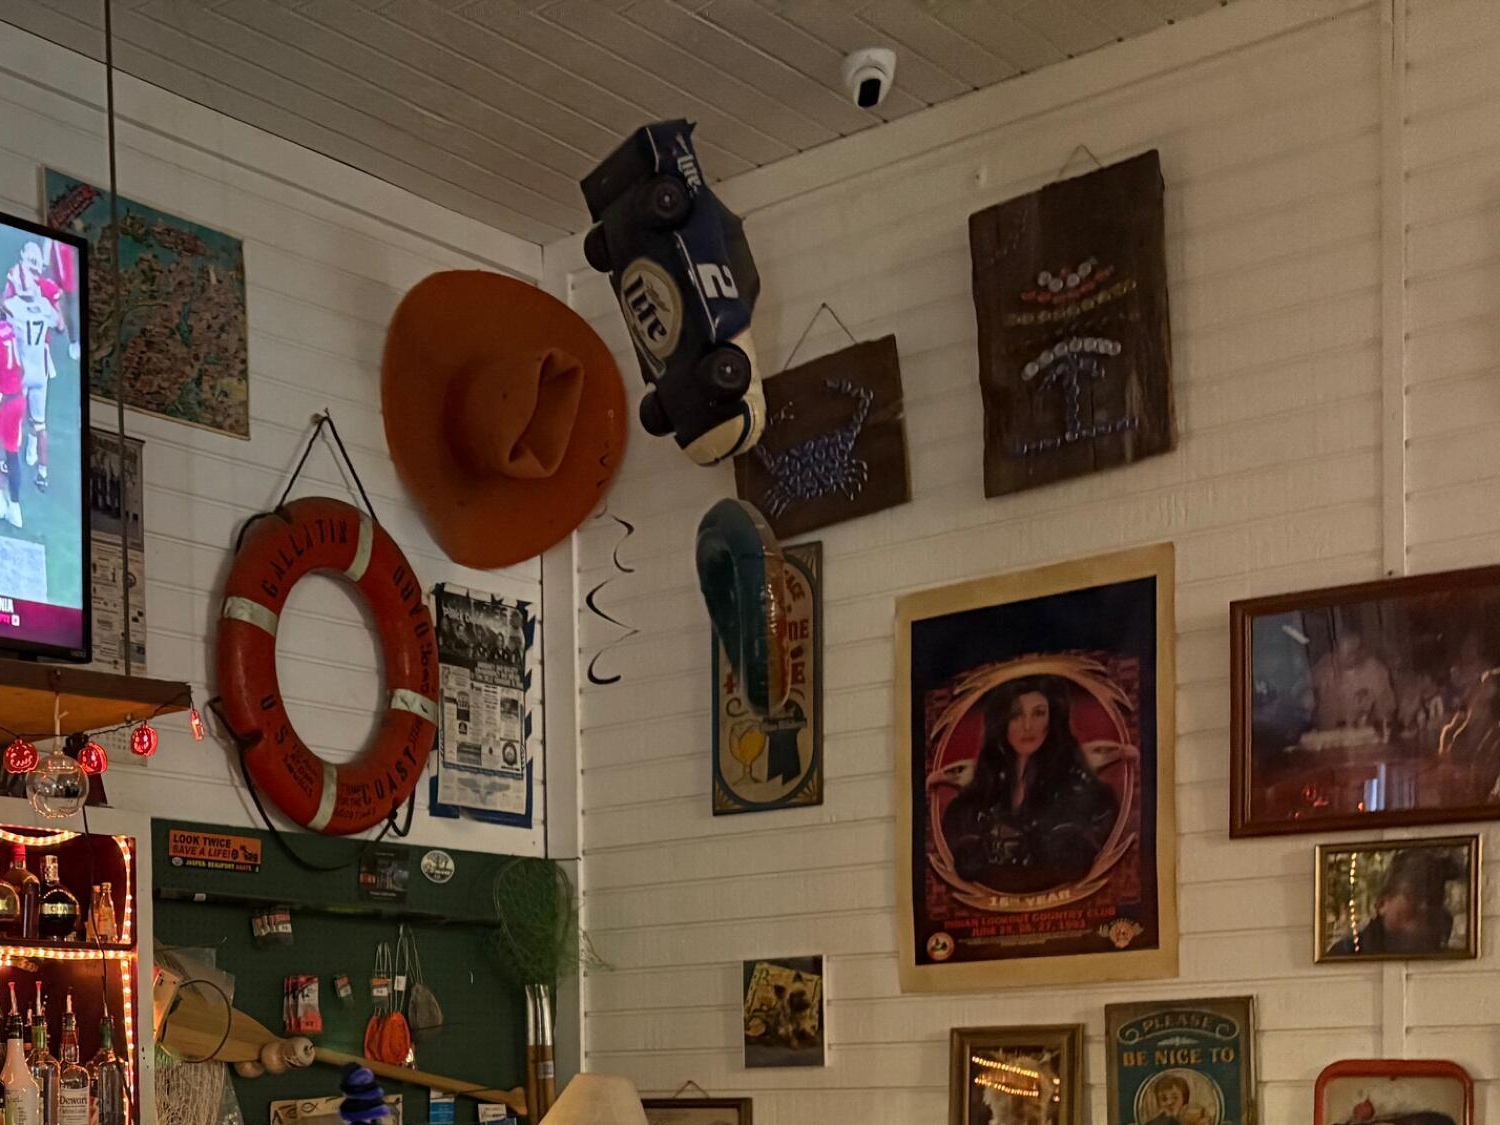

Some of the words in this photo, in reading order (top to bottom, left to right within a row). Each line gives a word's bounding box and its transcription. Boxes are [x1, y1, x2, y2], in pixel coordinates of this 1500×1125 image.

[696, 264, 739, 299] 2
[26, 321, 44, 346] 17
[173, 834, 200, 844] LOOK
[202, 836, 231, 848] TWICE
[172, 845, 197, 855] SAVE
[198, 848, 205, 857] A
[207, 848, 231, 858] LIFE!
[1027, 889, 1071, 907] YEAR
[1031, 909, 1084, 922] COUNTRY
[1142, 1013, 1215, 1034] PLEASE
[1123, 1051, 1147, 1068] BE
[1155, 1048, 1202, 1066] NICE
[1211, 1046, 1236, 1064] TO
